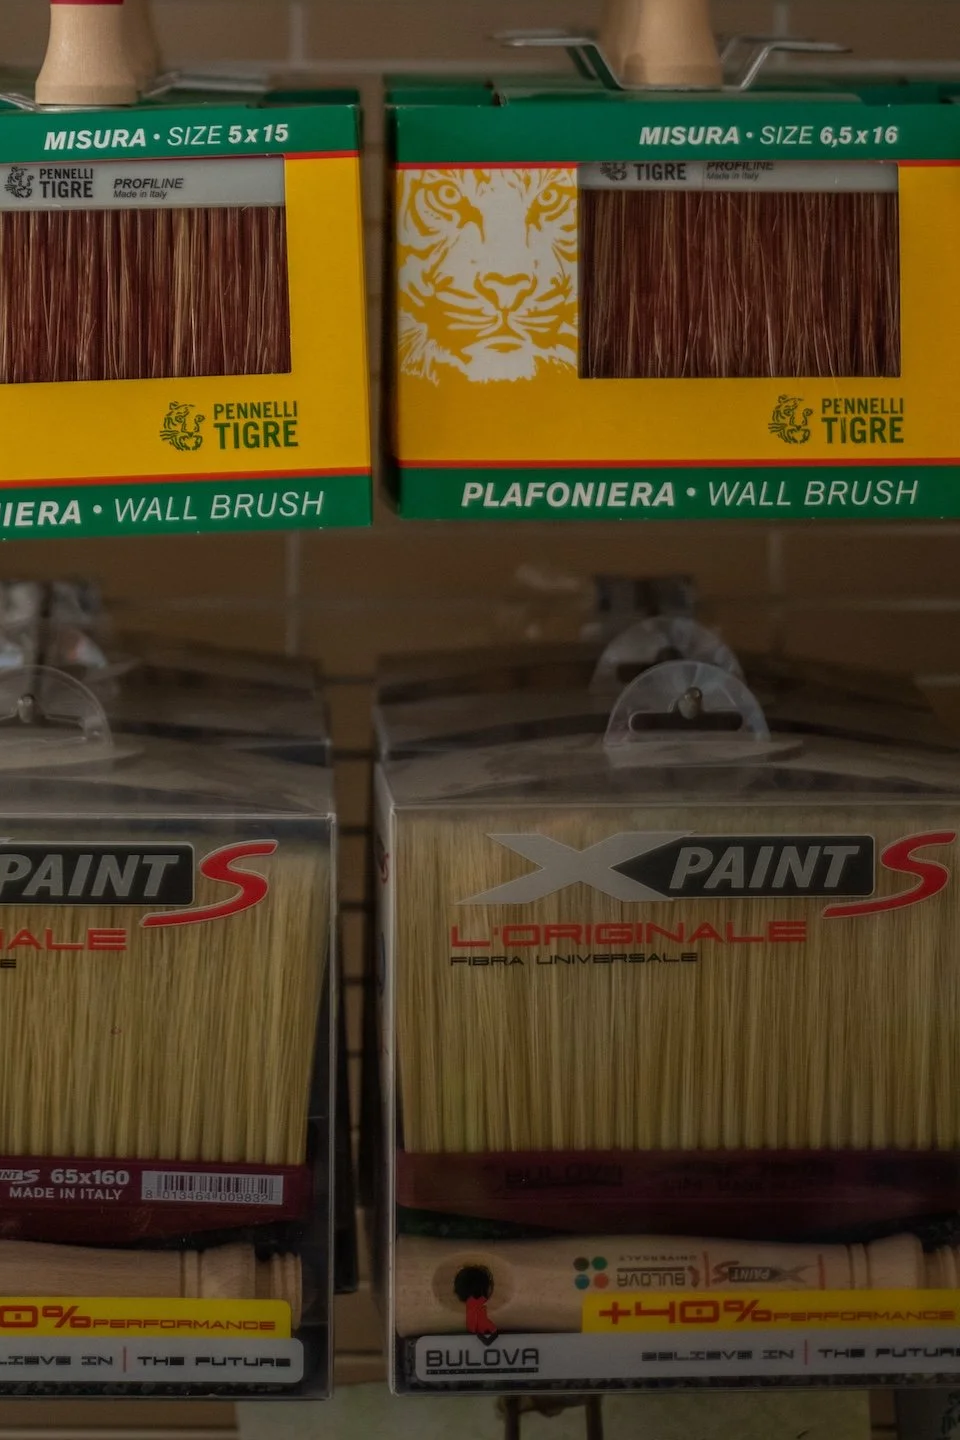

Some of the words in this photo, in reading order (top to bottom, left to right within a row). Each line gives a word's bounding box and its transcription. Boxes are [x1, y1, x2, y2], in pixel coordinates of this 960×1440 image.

[43, 128, 147, 152] MISURA
[166, 125, 223, 147] SIZE
[638, 125, 741, 146] MISURA
[759, 125, 815, 145] SIZE
[39, 166, 94, 182] PENNELLI
[632, 162, 687, 181] TIGRE
[39, 180, 94, 200] TIGRE
[113, 176, 185, 190] PROFILINE
[113, 188, 138, 199] Made
[149, 189, 169, 201] Italy
[212, 400, 299, 420] PENNELLI
[821, 396, 905, 416] PENNELLI
[213, 420, 300, 450] TIGRE
[821, 416, 905, 445] TIGRE
[461, 481, 676, 508] PLAFONIERA
[708, 480, 792, 506] WALL
[803, 479, 919, 506] BRUSH
[115, 493, 198, 523] WALL
[210, 489, 326, 518] BRUSH
[669, 845, 860, 890] PAINT
[450, 918, 808, 948] L'ORIGINALE
[449, 955, 525, 967] FIBRA
[536, 952, 699, 965] UNIVERSALE
[50, 1168, 130, 1185] 65x160
[9, 1186, 54, 1199] MADE
[59, 1187, 76, 1199] IN
[78, 1187, 123, 1201] ITALY
[616, 1271, 686, 1288] BULOVA
[92, 1319, 277, 1331] PERFORMANCE
[773, 1309, 956, 1323] PERFORMANCE
[81, 1355, 114, 1366] IN
[137, 1355, 186, 1367] THE
[195, 1356, 292, 1368] FUTURE
[425, 1346, 540, 1367] BULOVA
[763, 1348, 795, 1360] IN
[817, 1347, 866, 1358] THE
[875, 1347, 960, 1359] FUTUR
